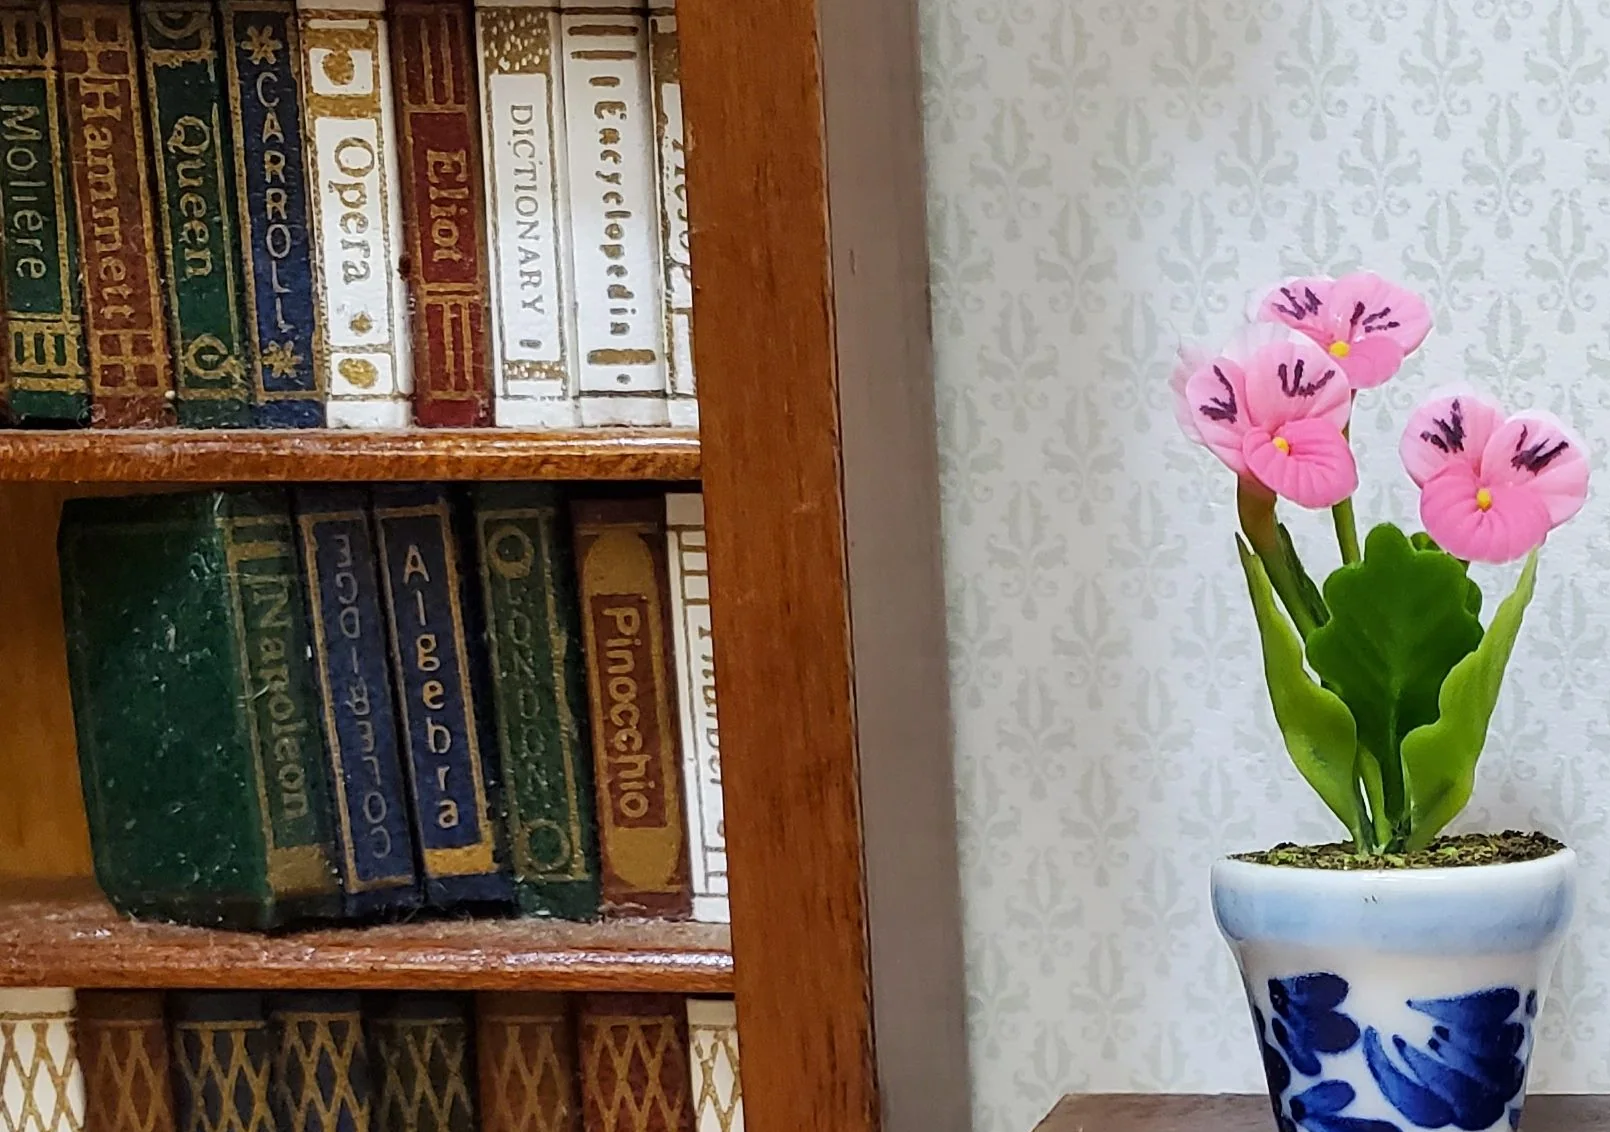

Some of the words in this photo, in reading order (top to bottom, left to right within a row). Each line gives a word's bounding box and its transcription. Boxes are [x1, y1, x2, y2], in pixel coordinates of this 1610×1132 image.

[79, 80, 136, 322] Hammett
[166, 114, 214, 278] Queen
[256, 71, 294, 333] CARROLL
[327, 136, 376, 286] Opera
[425, 148, 470, 264] Eliot
[509, 104, 545, 316] DICTIONARY
[402, 544, 460, 829] Algebra
[602, 606, 656, 820] Pinocchio
